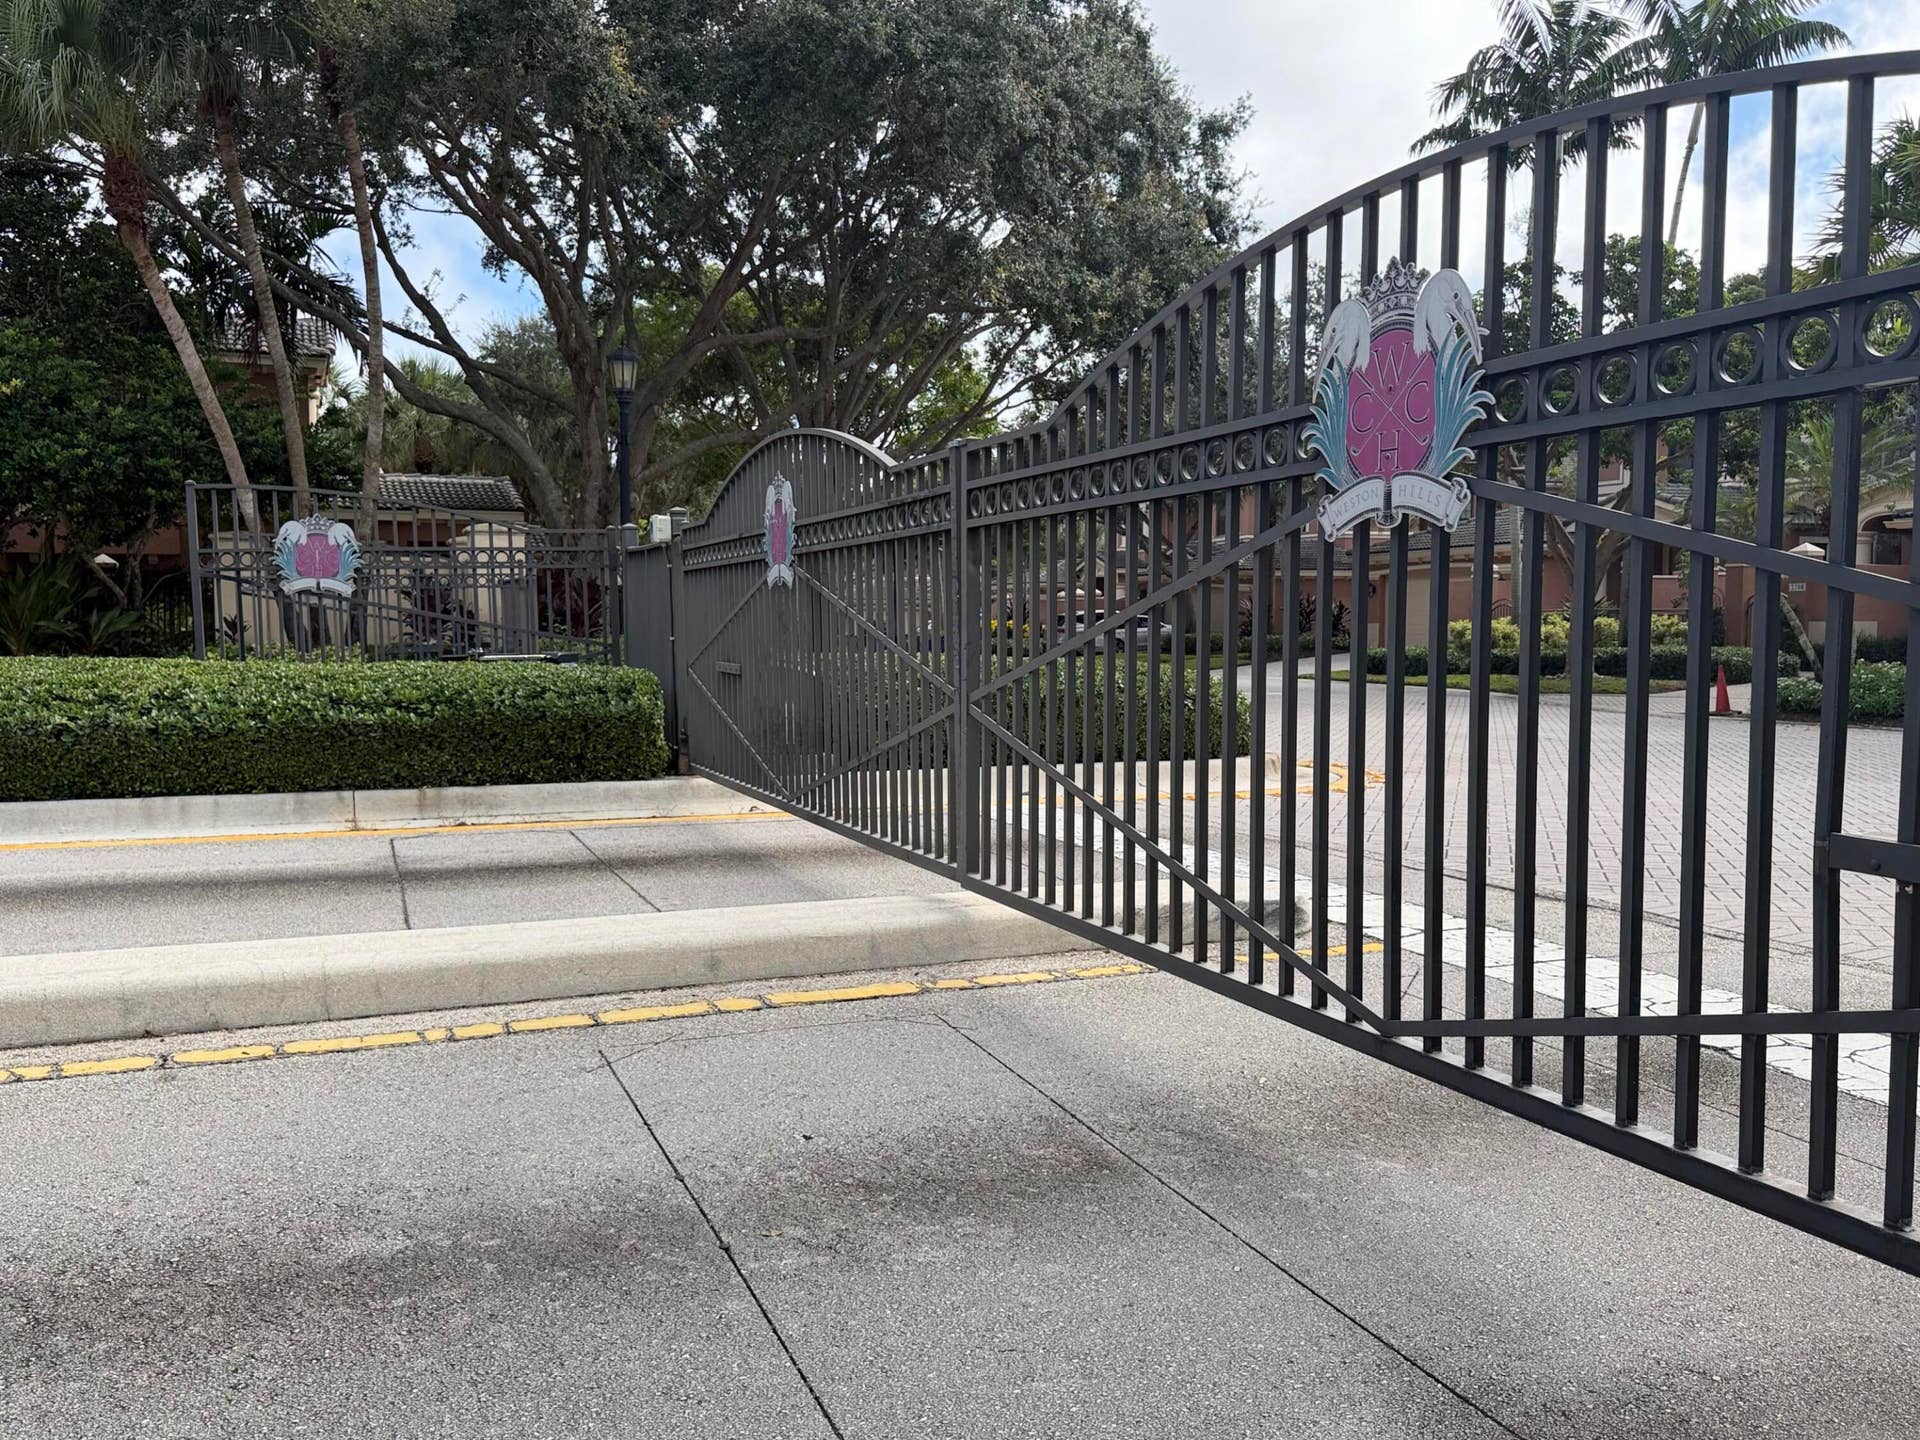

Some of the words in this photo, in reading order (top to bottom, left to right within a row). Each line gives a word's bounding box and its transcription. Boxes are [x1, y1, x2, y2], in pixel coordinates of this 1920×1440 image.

[1372, 341, 1409, 387] W
[1350, 392, 1374, 433] C
[1404, 380, 1430, 423] C
[1375, 429, 1404, 472] H
[1333, 487, 1379, 519] WESTON
[1398, 484, 1442, 508] HILLS
